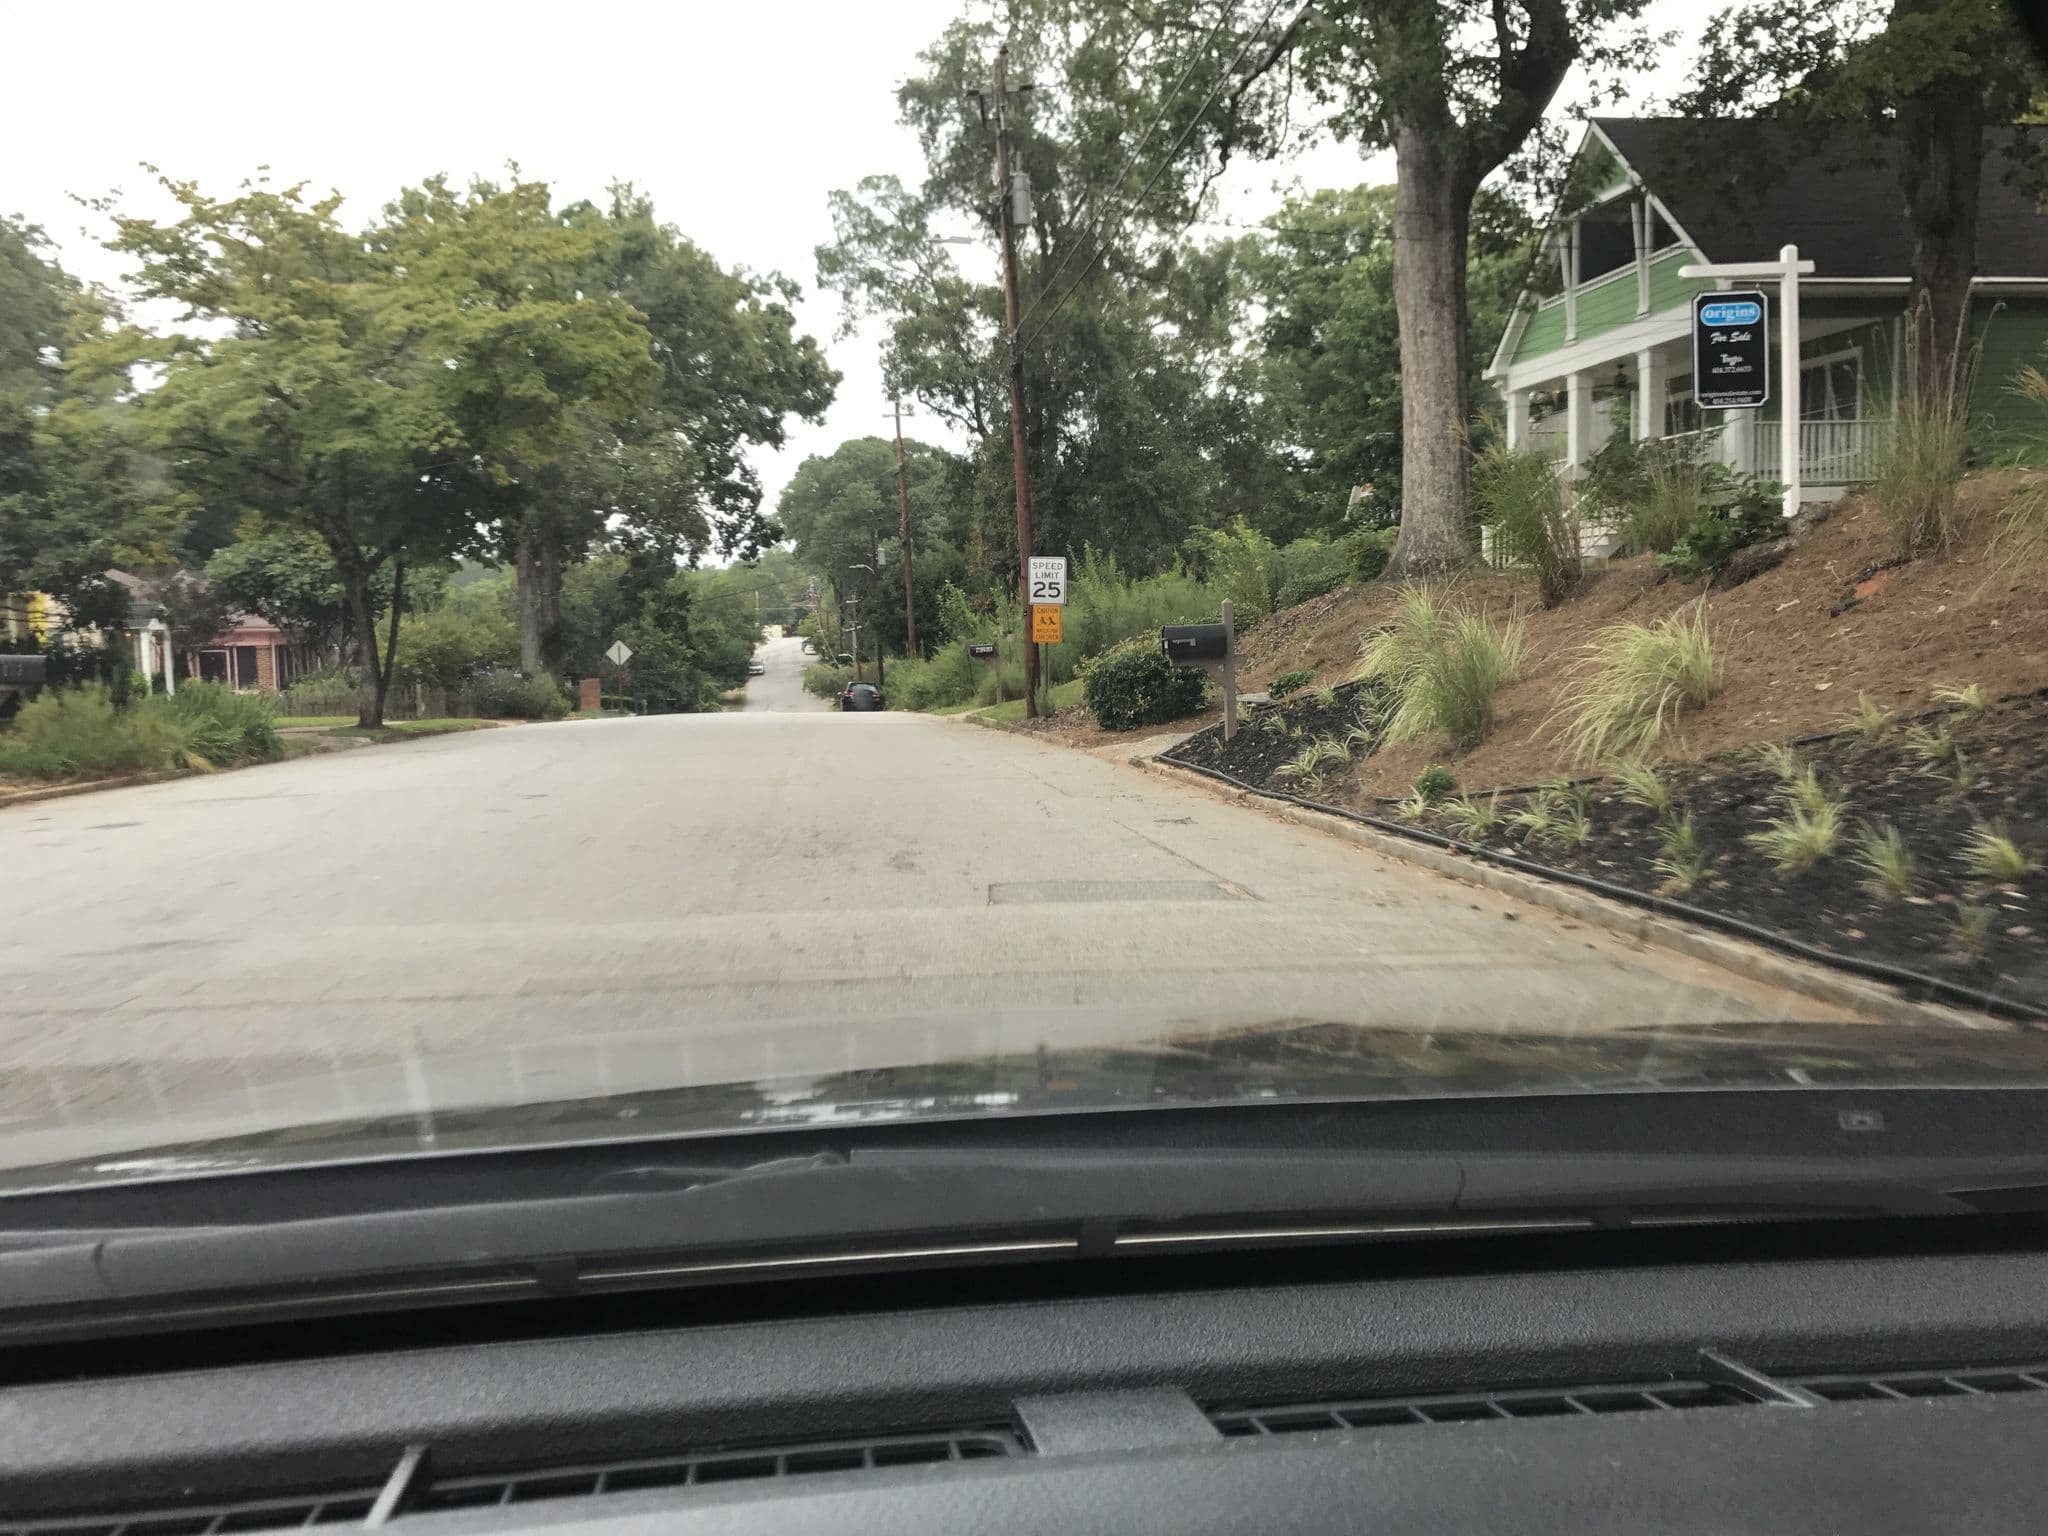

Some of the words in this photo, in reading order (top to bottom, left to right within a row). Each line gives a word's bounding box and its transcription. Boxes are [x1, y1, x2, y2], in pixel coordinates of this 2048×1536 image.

[1704, 306, 1756, 321] origins
[1710, 331, 1728, 345] For
[1729, 330, 1752, 343] Sale
[1033, 581, 1061, 598] 25
